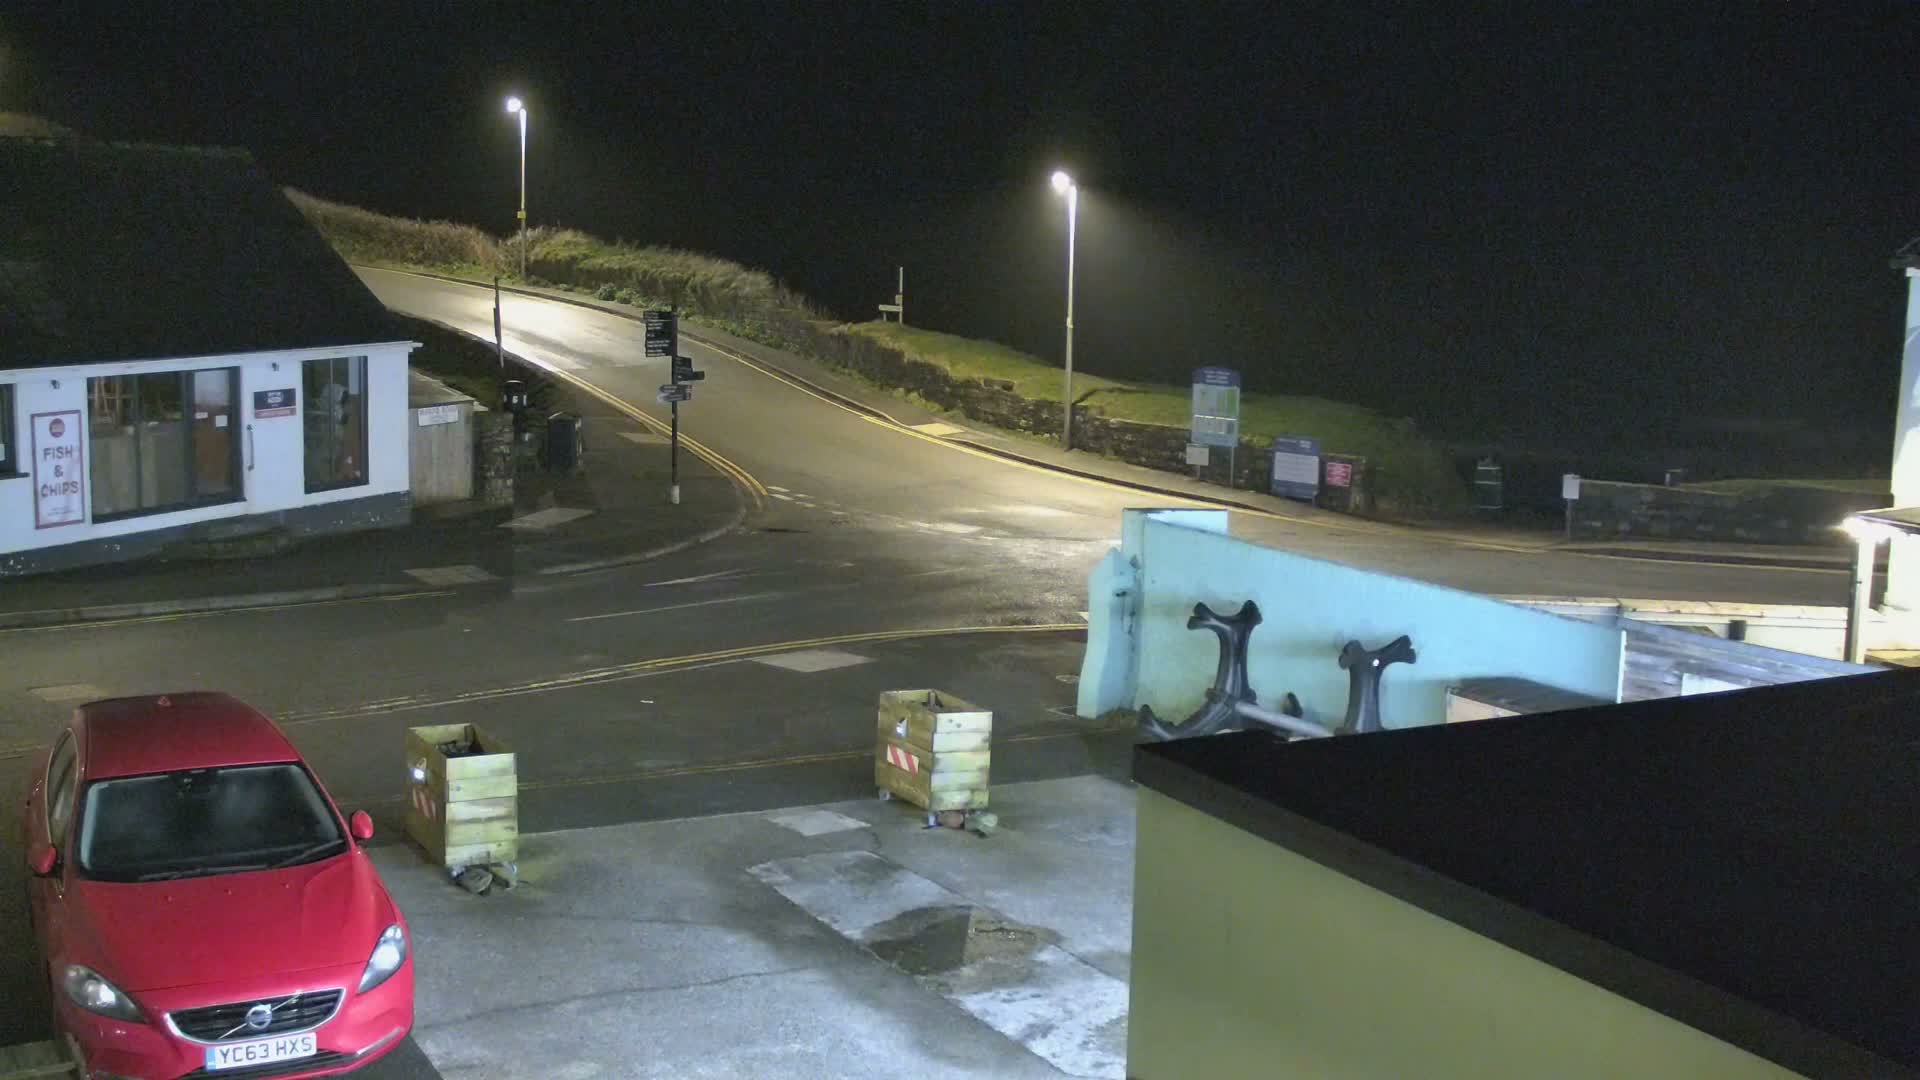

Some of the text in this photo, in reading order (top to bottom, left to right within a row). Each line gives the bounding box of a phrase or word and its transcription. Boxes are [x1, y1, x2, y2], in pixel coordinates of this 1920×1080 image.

[43, 445, 73, 460] FISH
[54, 465, 64, 477] &
[41, 481, 79, 497] CHIPS
[219, 1037, 312, 1064] YC63 HXS
